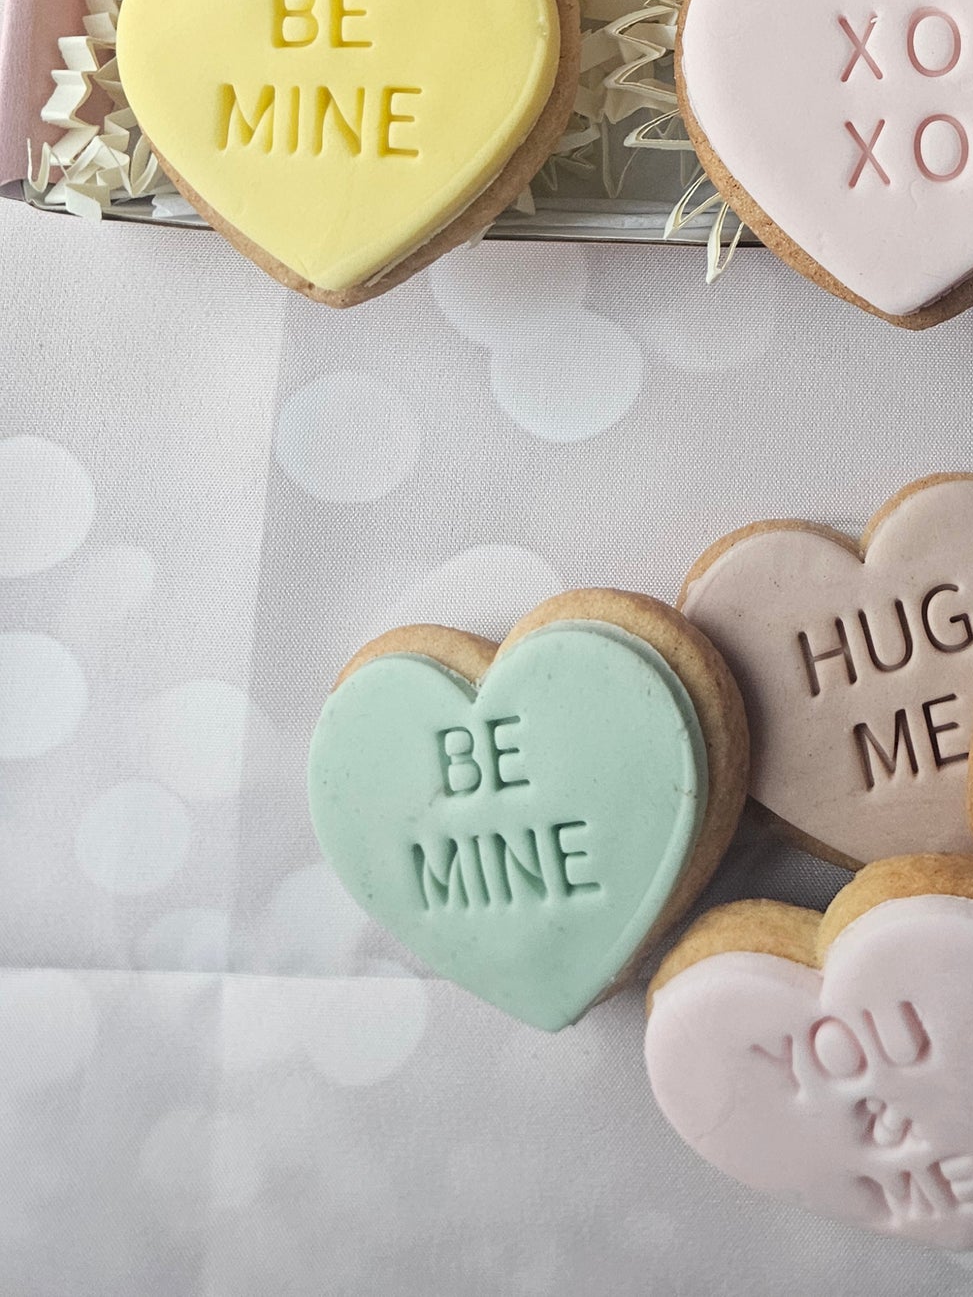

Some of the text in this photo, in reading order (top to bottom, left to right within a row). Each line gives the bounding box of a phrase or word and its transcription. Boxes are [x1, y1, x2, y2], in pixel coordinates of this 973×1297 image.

[837, 4, 962, 85] XO
[216, 83, 423, 159] MINE
[845, 113, 968, 190] XO
[434, 714, 530, 800] BE
[850, 693, 969, 793] ME
[411, 819, 602, 913] MINE
[750, 1000, 932, 1096] YOU
[856, 1096, 918, 1151] &
